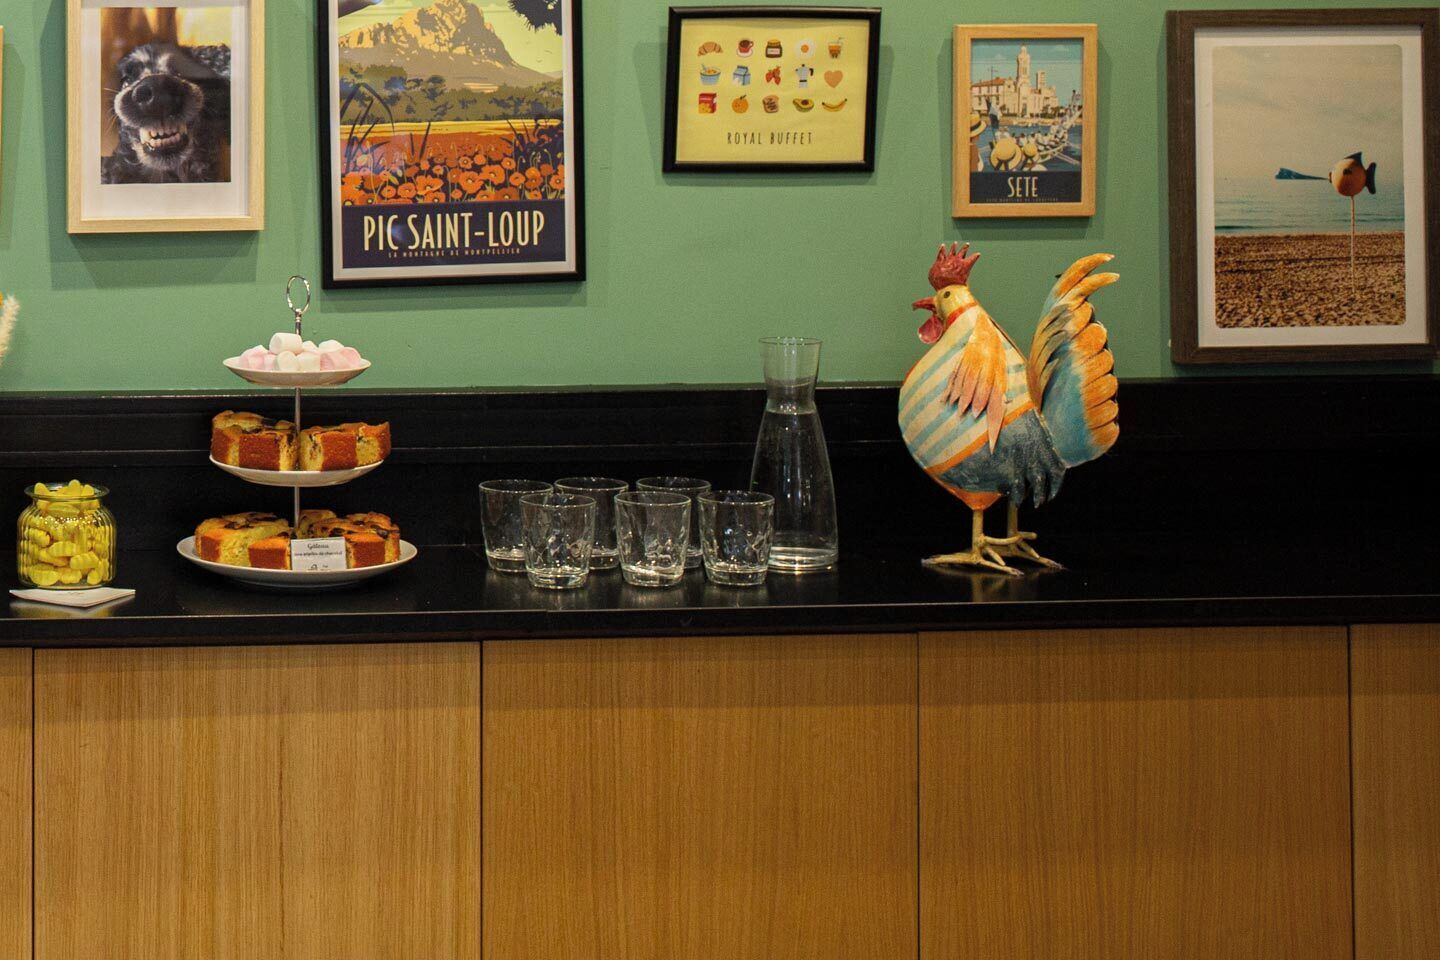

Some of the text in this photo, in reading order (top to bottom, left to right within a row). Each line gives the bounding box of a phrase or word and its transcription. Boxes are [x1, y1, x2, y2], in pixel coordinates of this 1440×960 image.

[727, 132, 812, 145] ROYAL BUFFET
[1007, 176, 1039, 198] SETE
[363, 210, 545, 251] PIC SAINT-LOUP
